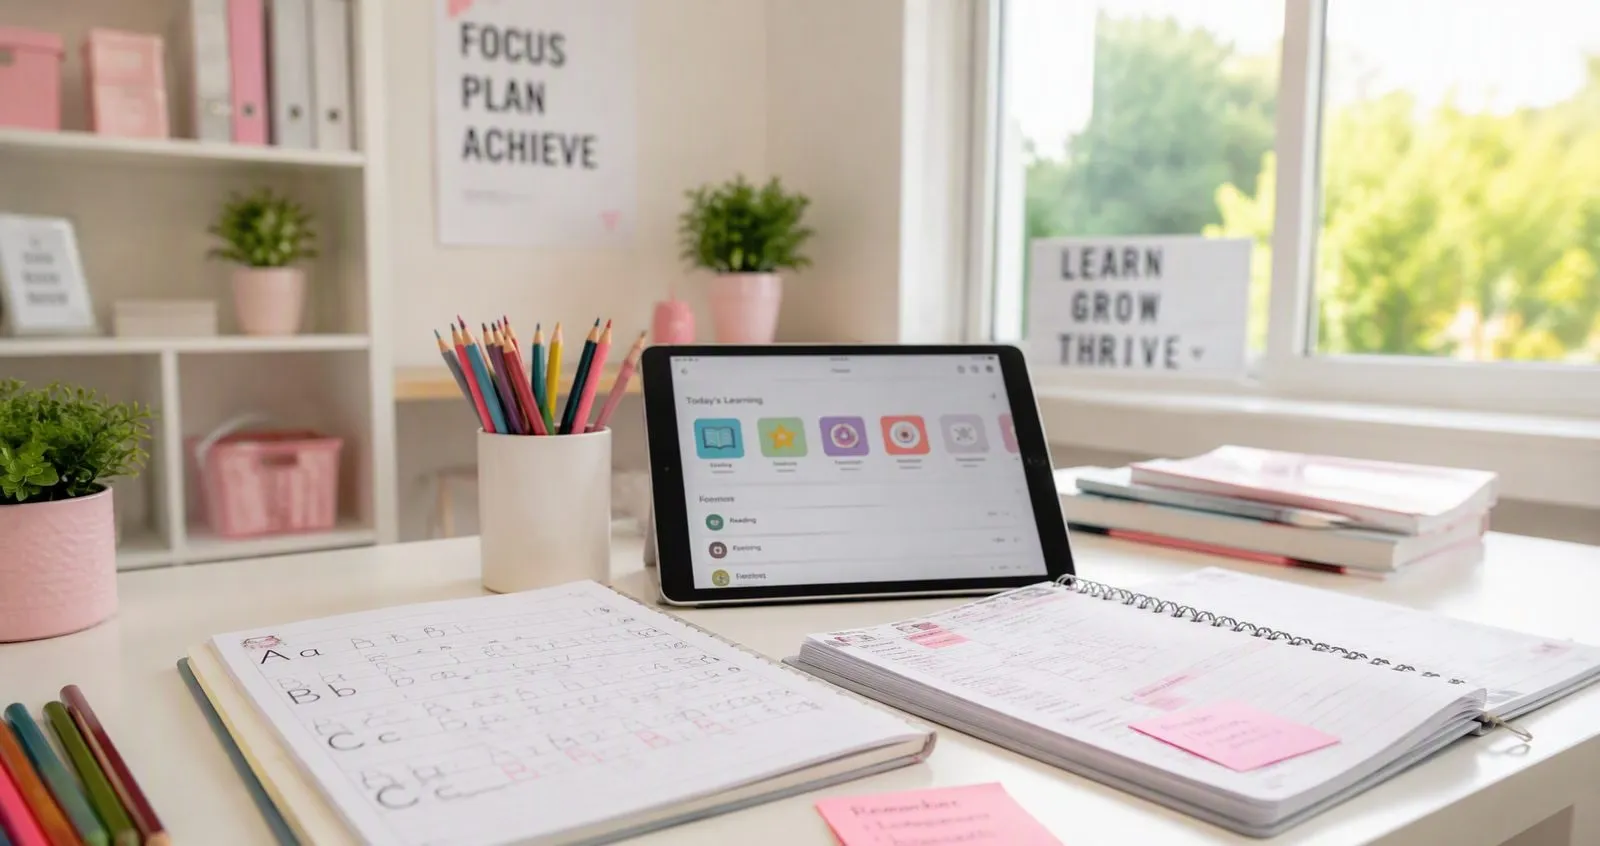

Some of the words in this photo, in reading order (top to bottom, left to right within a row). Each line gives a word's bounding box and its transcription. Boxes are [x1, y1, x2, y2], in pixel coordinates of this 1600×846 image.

[460, 21, 566, 68] FOCUS
[461, 74, 545, 116] PLAN
[462, 125, 599, 170] ACHIEVE
[1060, 247, 1162, 280] LEARN
[1071, 291, 1160, 323] GROW
[1058, 335, 1180, 369] THRIVE
[686, 396, 721, 406] Today's
[724, 397, 764, 406] Learning
[260, 649, 290, 664] A
[299, 648, 323, 658] a
[286, 688, 321, 704] B
[327, 684, 357, 697] b
[327, 731, 365, 751] C
